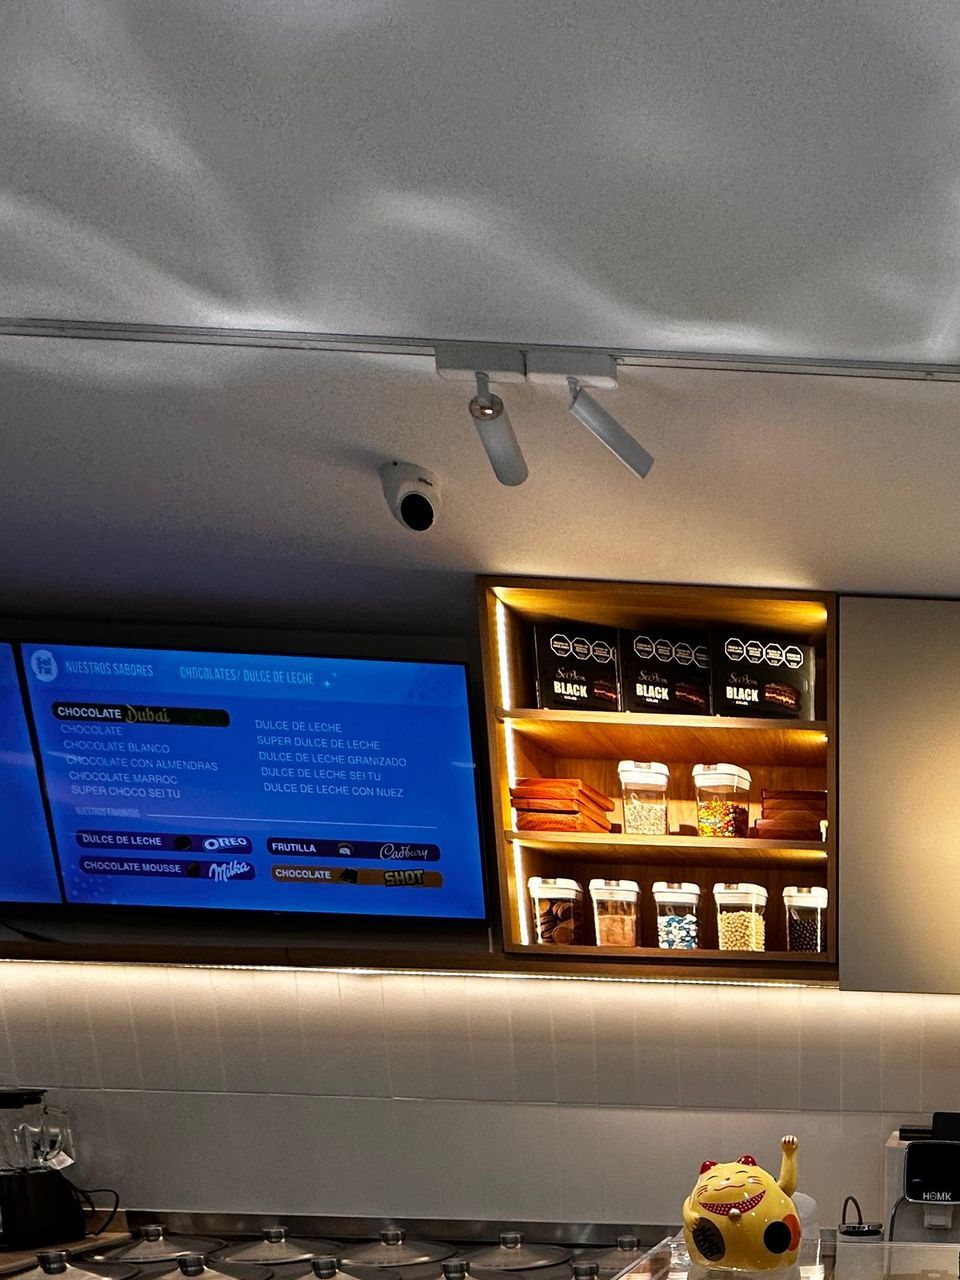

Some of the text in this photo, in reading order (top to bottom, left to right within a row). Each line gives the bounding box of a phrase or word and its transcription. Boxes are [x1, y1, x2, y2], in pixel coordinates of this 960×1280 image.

[65, 660, 154, 677] NUESTROS SABORES
[243, 669, 271, 683] DULCE
[273, 670, 285, 683] DE
[287, 671, 315, 685] LECHE
[553, 680, 588, 698] BLACK
[635, 683, 669, 700] BLACK
[726, 686, 759, 702] BLACK
[57, 704, 171, 724] CHOCOLATE Dubai
[60, 724, 123, 736] CHOCOLATE
[255, 720, 342, 733] DULCE DE LECHE
[63, 740, 170, 754] CHOCOLATE BLANCO
[257, 735, 380, 750] SUPER DULCE DE LECHE
[66, 756, 218, 772] CHOCOLATE CON ALMENDRAS
[259, 751, 407, 767] DULCE DE LECHE GRANIZADO
[69, 771, 178, 785] CHOCOLATE MARROC
[261, 766, 381, 781] DULCE DE LECHE SEI TU
[71, 785, 181, 799] SUPER CHOCO SEI TU
[263, 782, 403, 798] DULCE DE LECHE CON NUEZ
[82, 834, 247, 851] DULCE DE LECHE OREO
[271, 842, 429, 861] FRUTILLA Cadbury
[83, 859, 250, 882] CHOCOLATE MOUSSE Milka
[275, 868, 424, 886] CHOCOLATE SHOT
